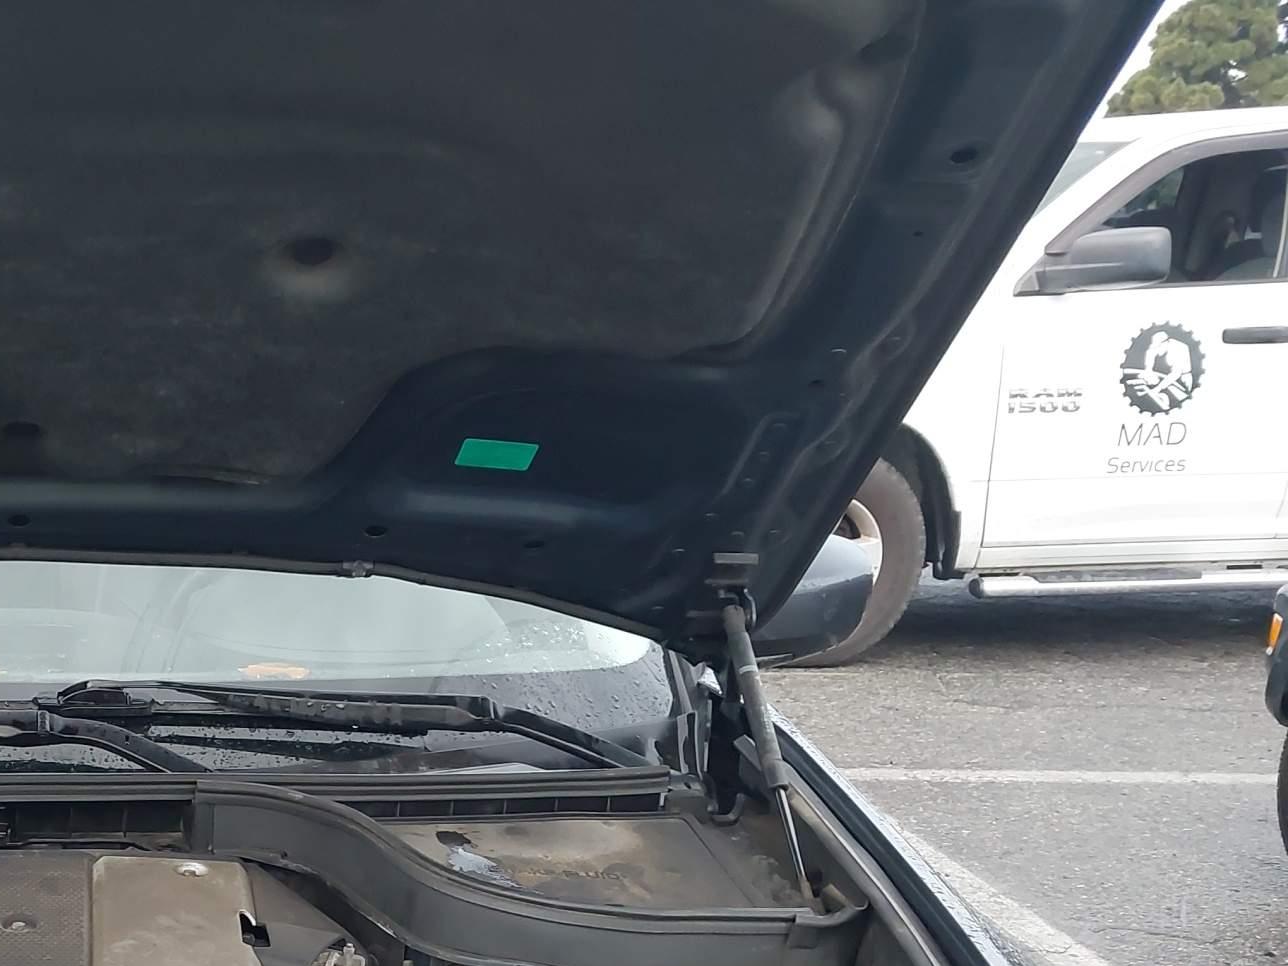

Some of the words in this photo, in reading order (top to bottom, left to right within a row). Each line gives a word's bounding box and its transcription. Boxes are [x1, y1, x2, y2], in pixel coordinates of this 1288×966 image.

[1008, 401, 1081, 414] 1500
[1117, 421, 1188, 446] MAD
[1106, 456, 1187, 474] Services
